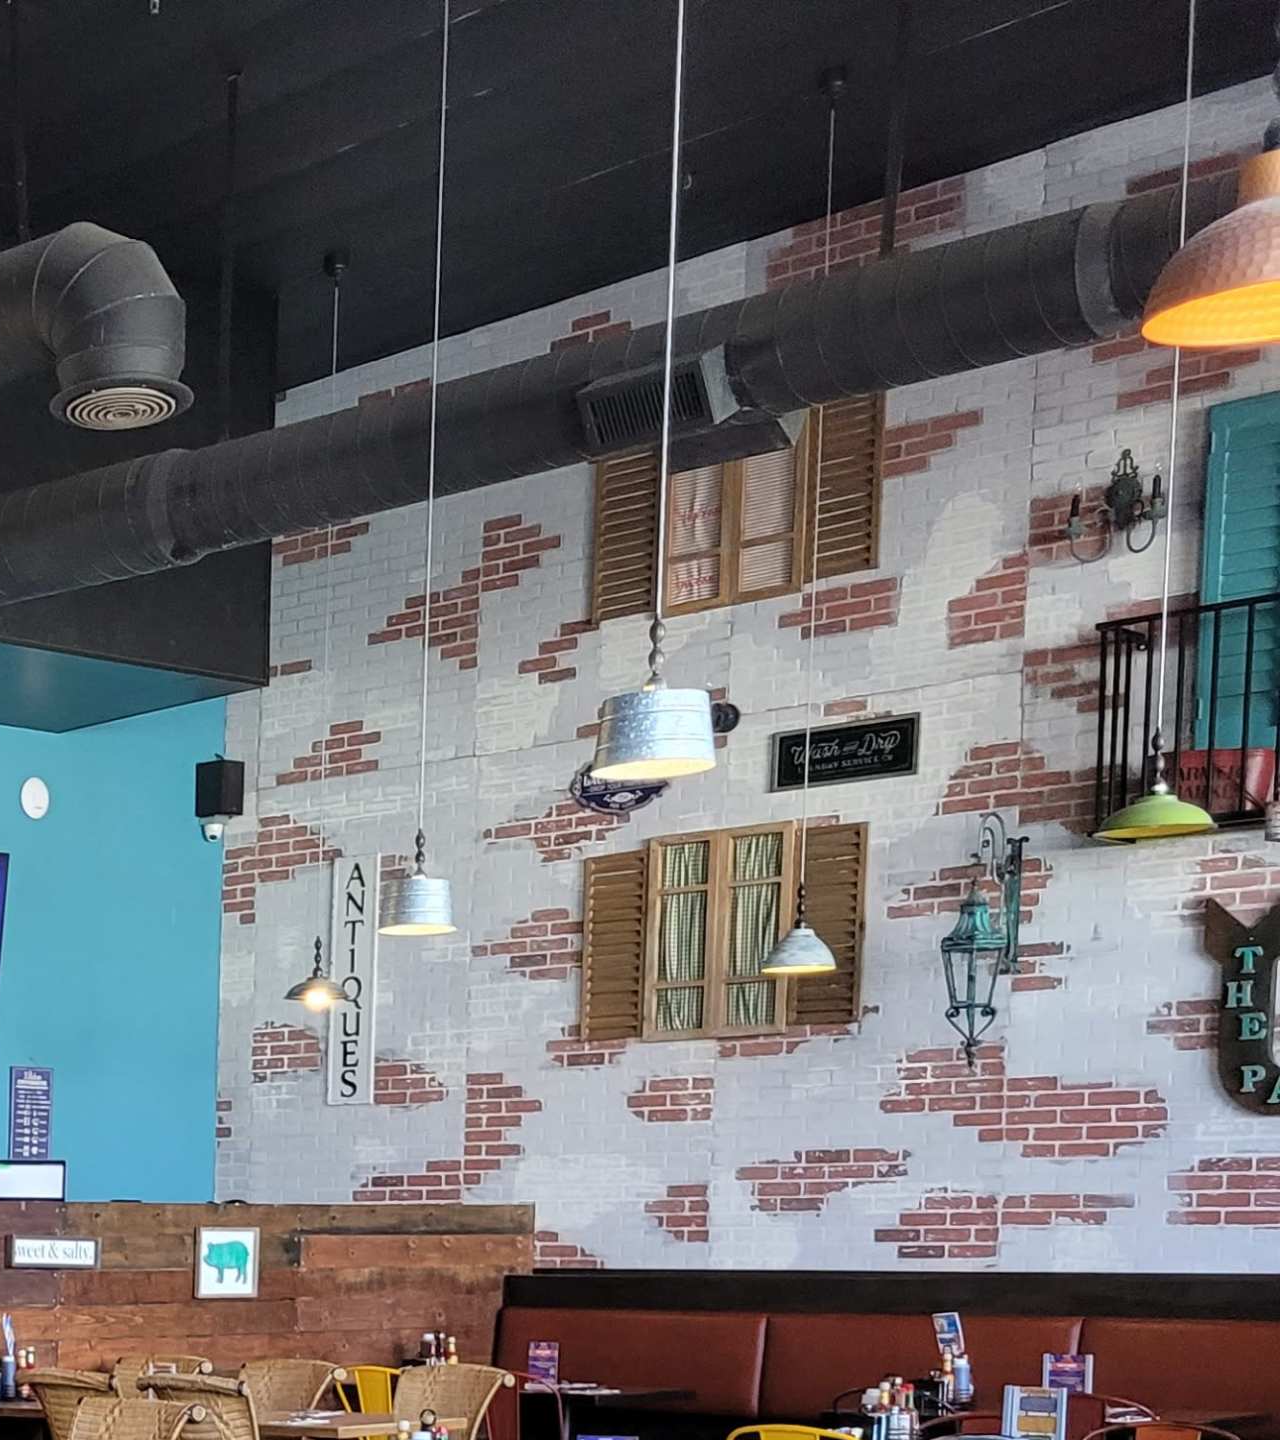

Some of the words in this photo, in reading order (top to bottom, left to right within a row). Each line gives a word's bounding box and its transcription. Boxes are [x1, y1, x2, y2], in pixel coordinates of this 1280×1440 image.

[791, 738, 839, 765] Wash
[857, 730, 902, 757] Dry
[340, 862, 366, 1098] ANTIQUES
[1225, 946, 1268, 1041] THE
[15, 1244, 46, 1259] weet
